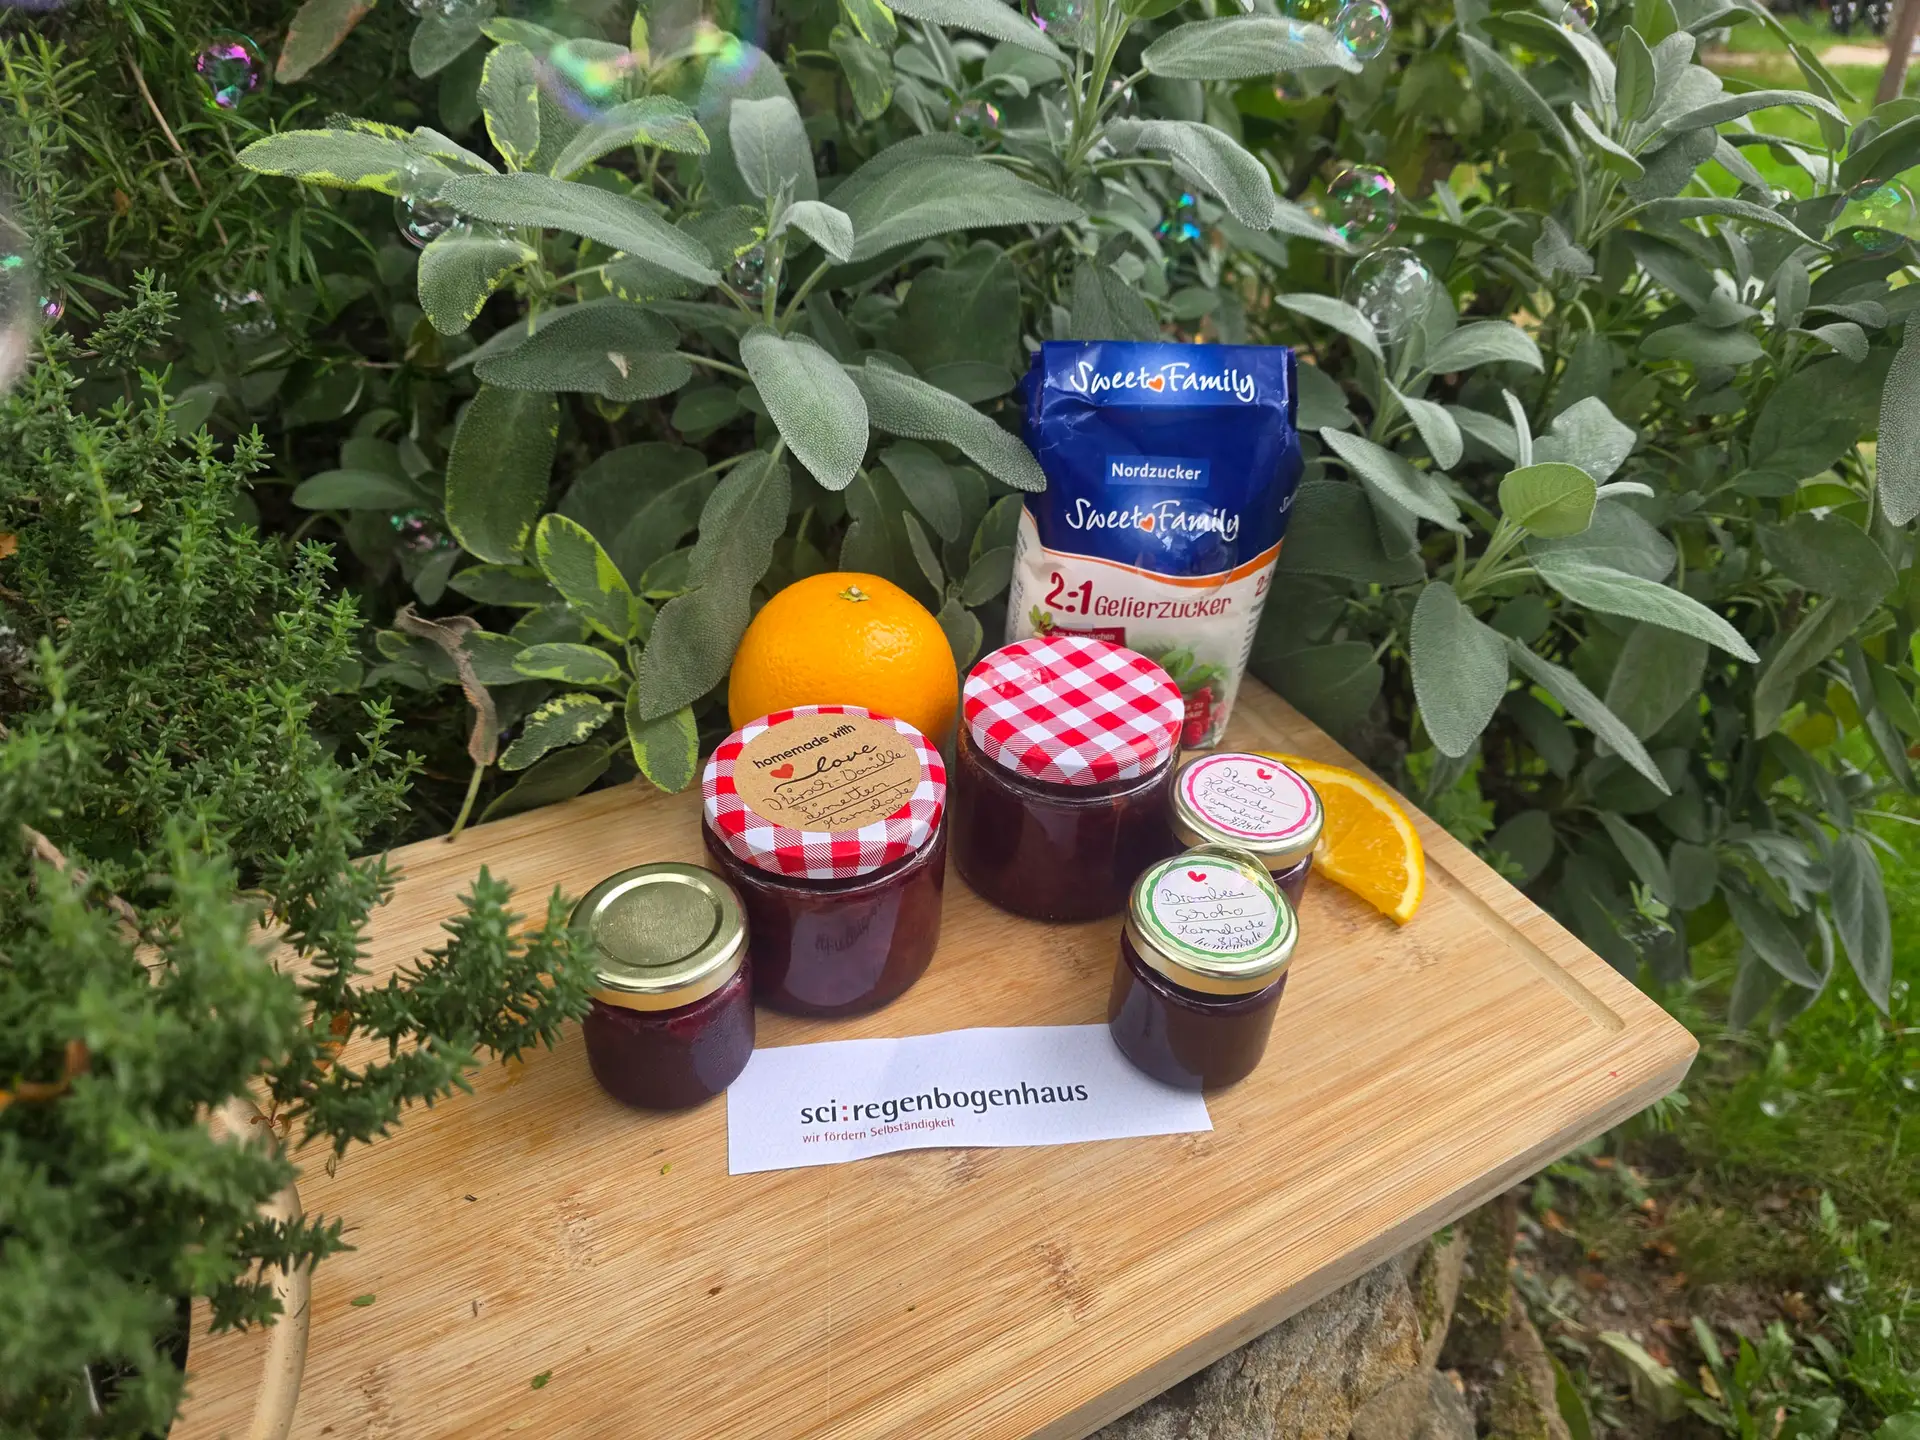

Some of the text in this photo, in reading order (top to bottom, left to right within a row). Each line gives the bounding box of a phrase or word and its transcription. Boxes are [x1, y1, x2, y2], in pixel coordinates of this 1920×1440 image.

[1070, 361, 1255, 402] Sweet Family
[1111, 463, 1202, 480] Nordzucker
[1066, 498, 1239, 541] Sweet Family
[1045, 572, 1093, 615] 2:1
[1094, 595, 1231, 619] Gelierzucker
[753, 724, 856, 769] homemade with
[773, 744, 877, 793] love
[800, 1082, 1088, 1124] sci:regenbogenhaus
[803, 1117, 956, 1143] wir fördern Selbständigkeit
